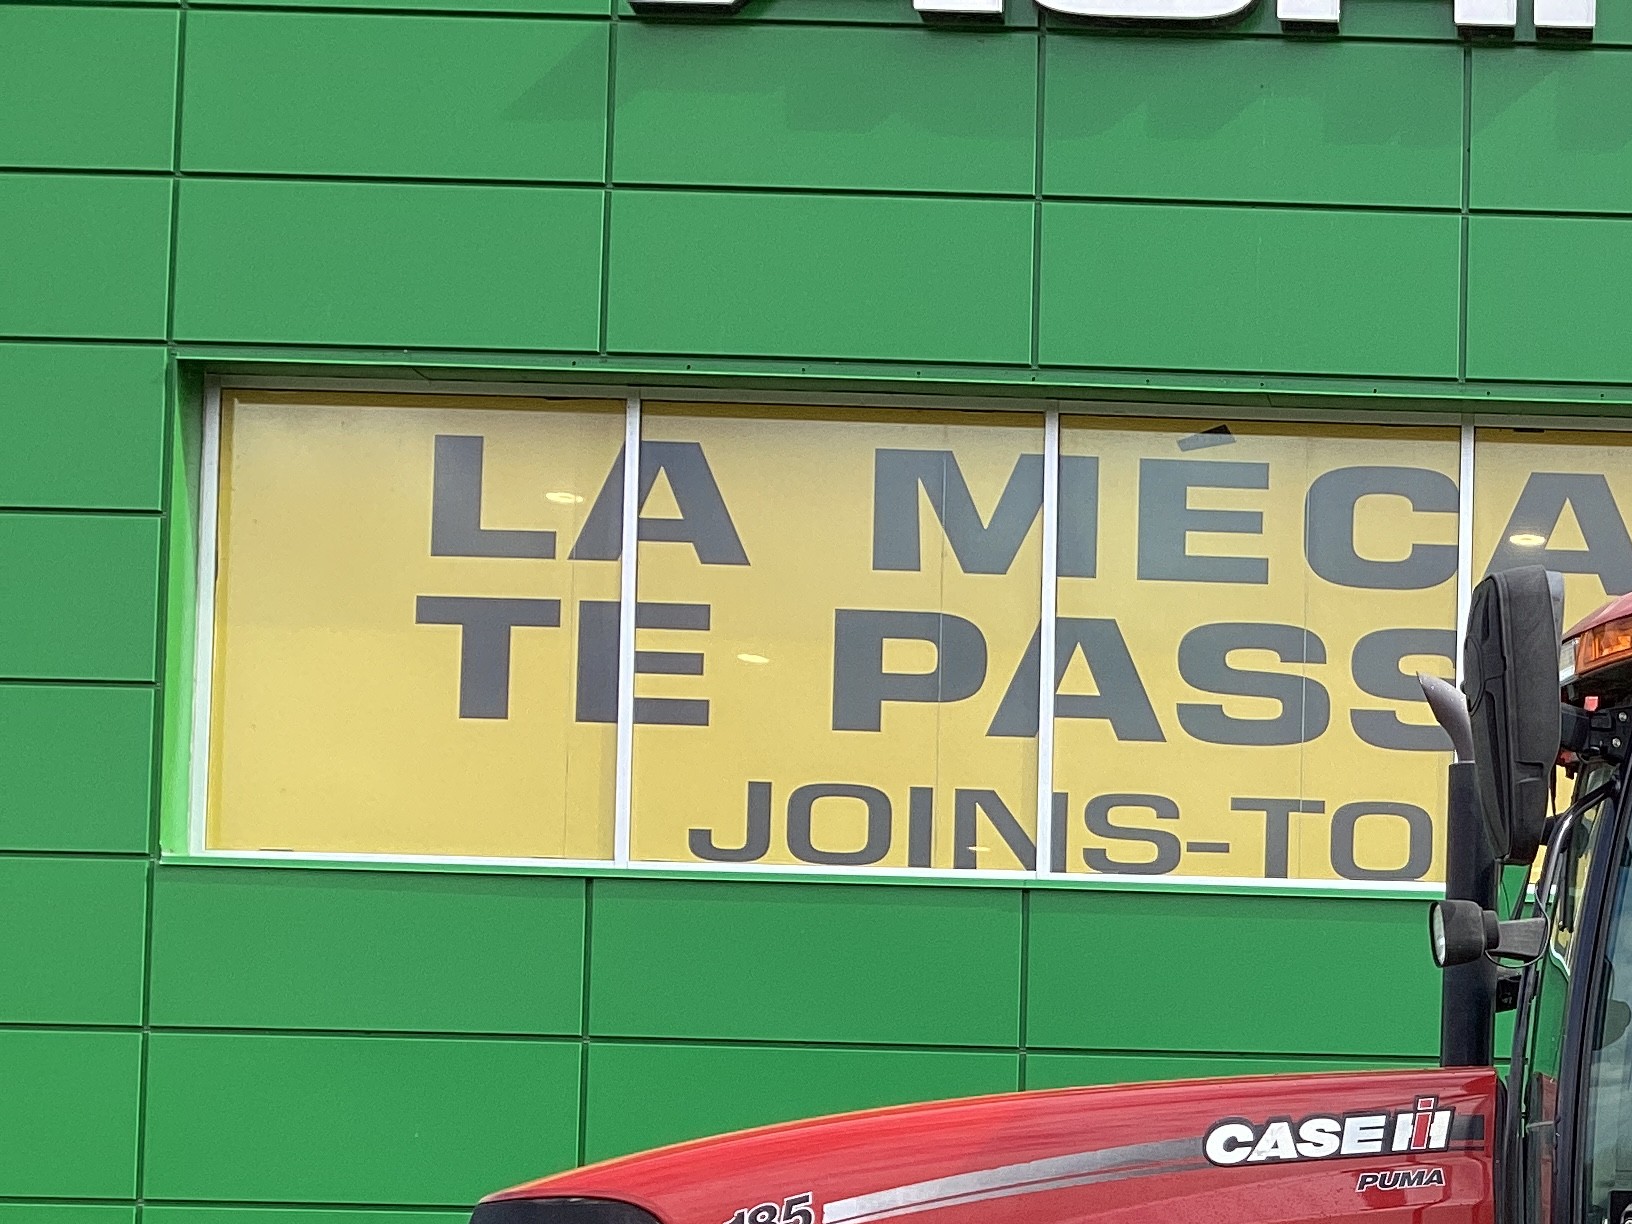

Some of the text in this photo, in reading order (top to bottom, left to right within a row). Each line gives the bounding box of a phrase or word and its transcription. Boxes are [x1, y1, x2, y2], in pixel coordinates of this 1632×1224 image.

[431, 434, 751, 567] LA
[415, 595, 711, 727] TE
[688, 781, 1434, 881] JOINS-TO
[1204, 1114, 1387, 1166] CASE
[1355, 1168, 1446, 1193] PUMA
